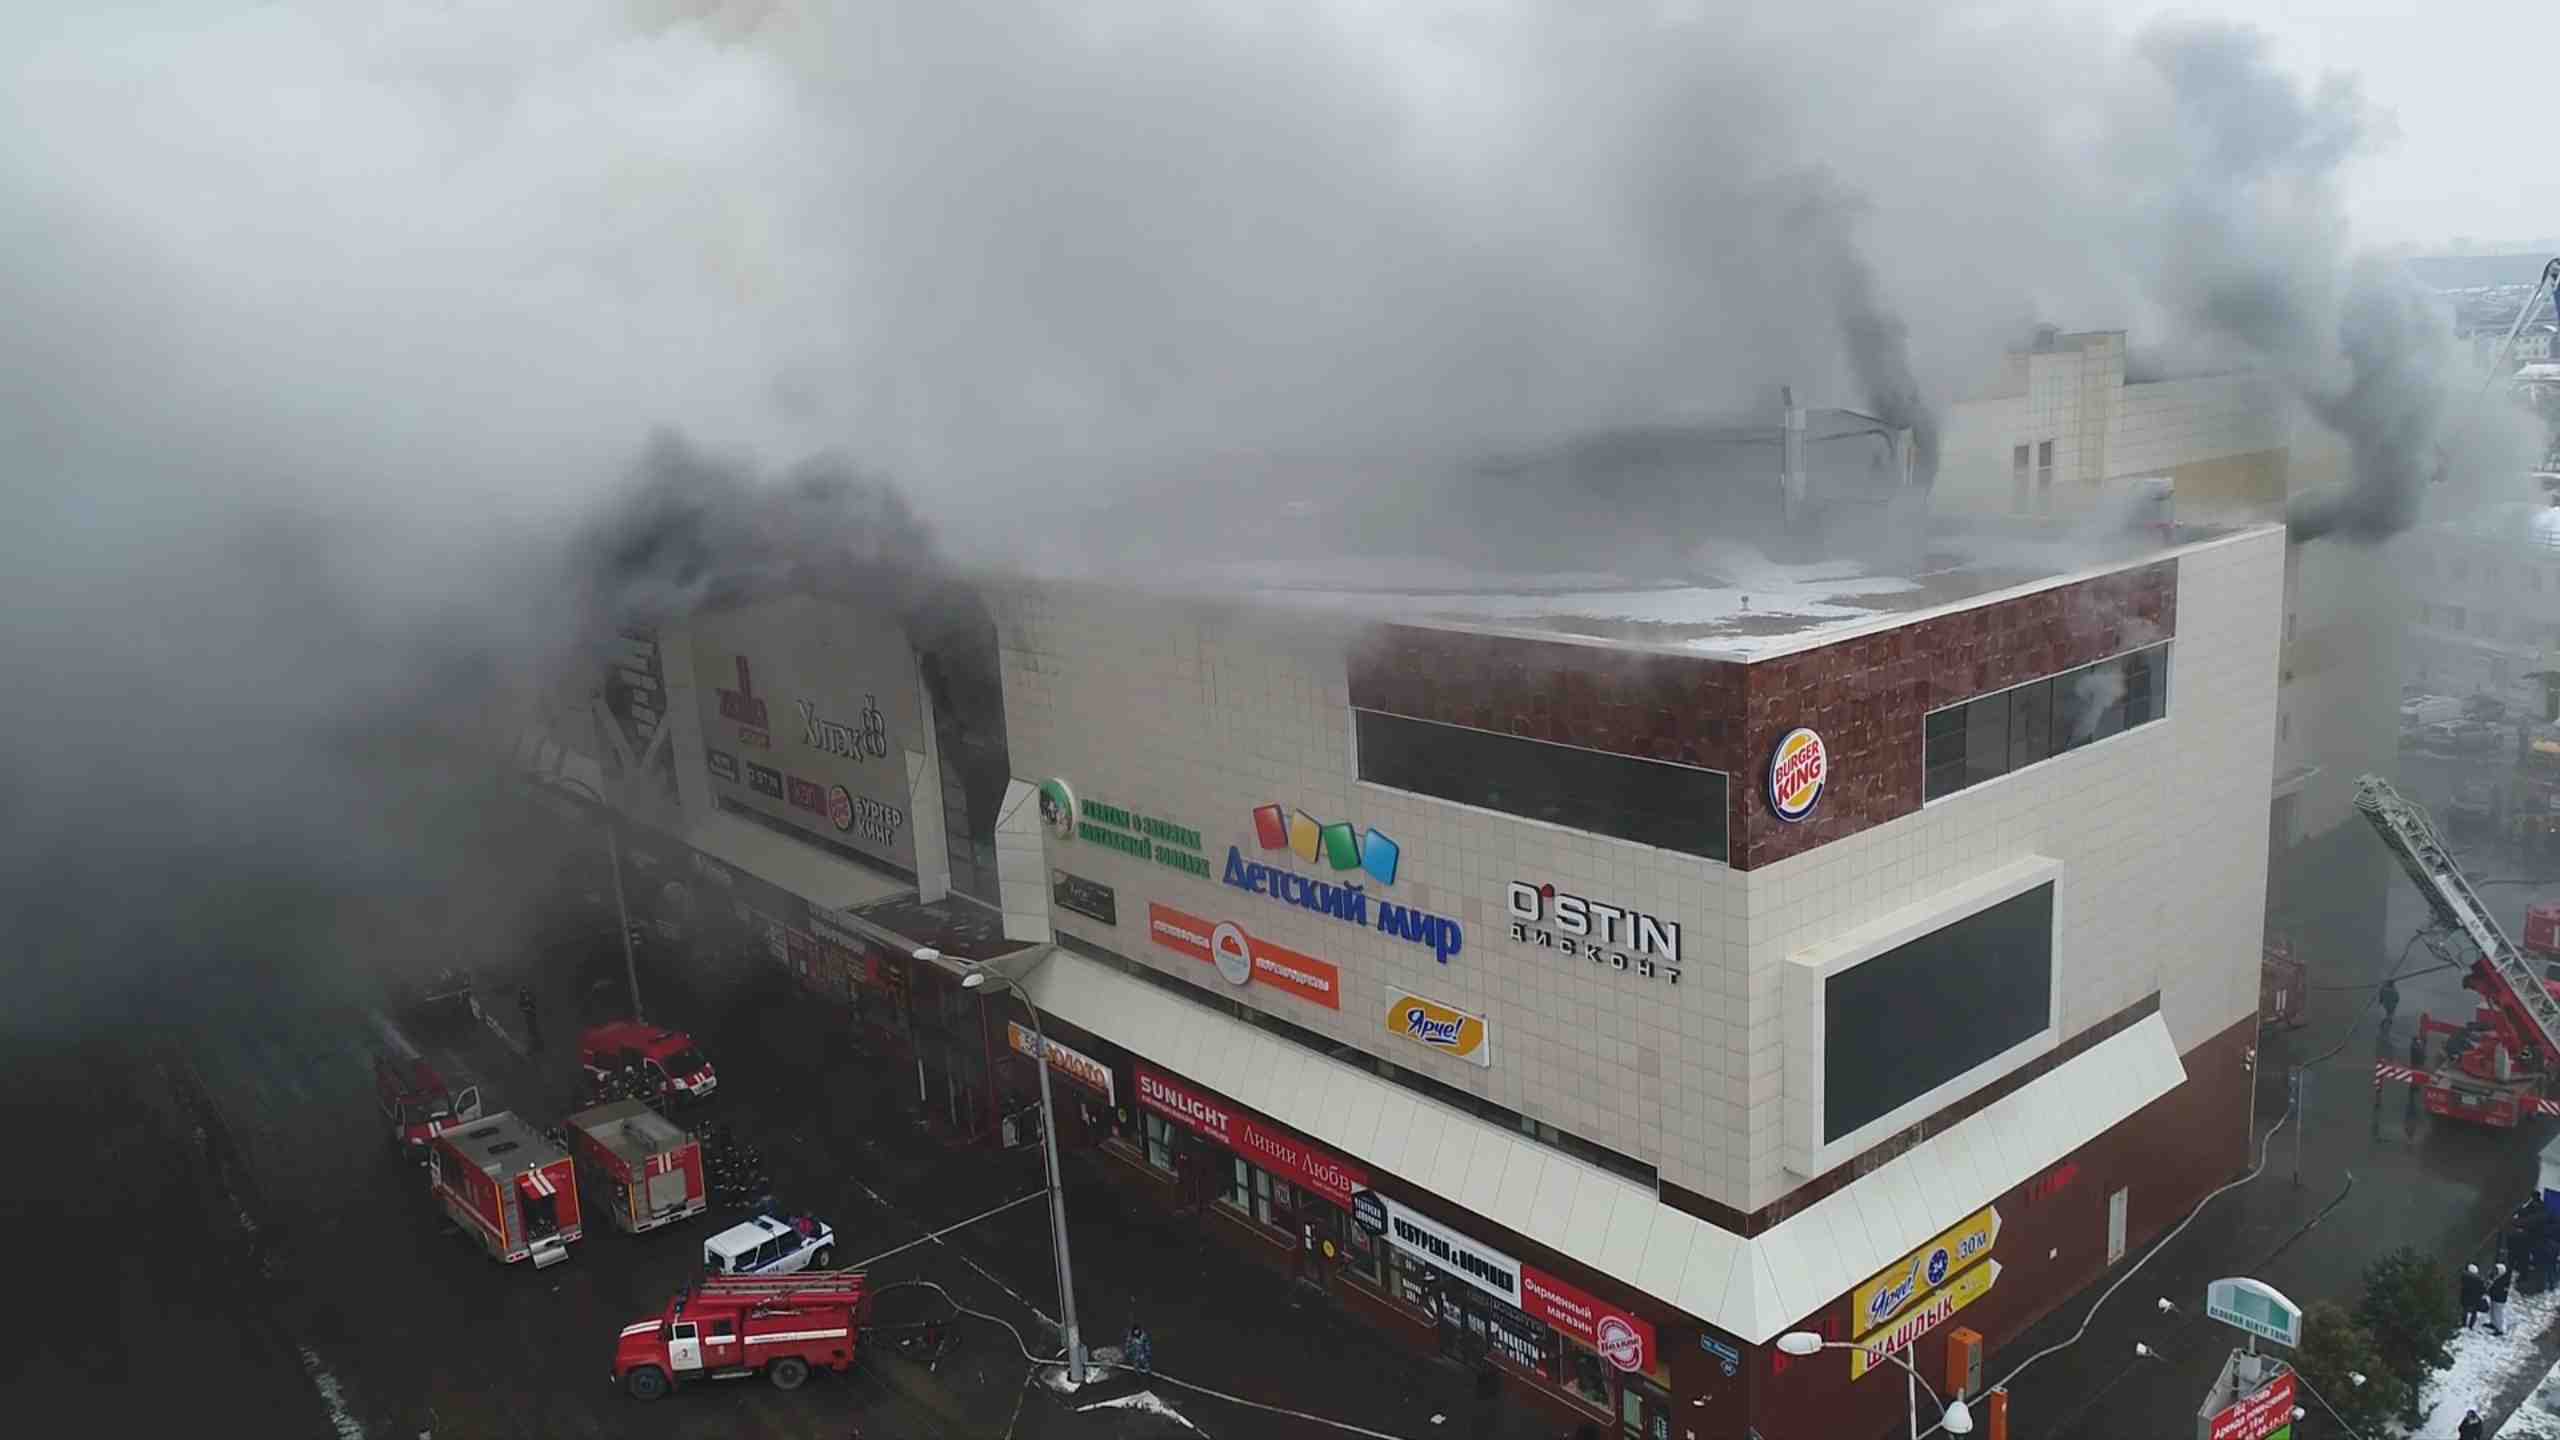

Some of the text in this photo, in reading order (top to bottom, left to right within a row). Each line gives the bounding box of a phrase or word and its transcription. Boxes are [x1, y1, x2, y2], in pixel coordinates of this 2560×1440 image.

[1775, 741, 1819, 784] BURGER
[1777, 757, 1822, 805] KING
[1222, 845, 1463, 965] Детский мир
[1407, 1008, 1463, 1045] Ярче!
[1141, 1075, 1228, 1131] SUNLIGHT
[1244, 1124, 1297, 1166] Линии
[1302, 1152, 1351, 1192] Любв
[1394, 1216, 1450, 1262] ЧЕБУРЕКИ
[1524, 1278, 1592, 1320] Фирменный
[1547, 1305, 1593, 1335] магазин
[1867, 1296, 1953, 1368] ШАШЛЫК
